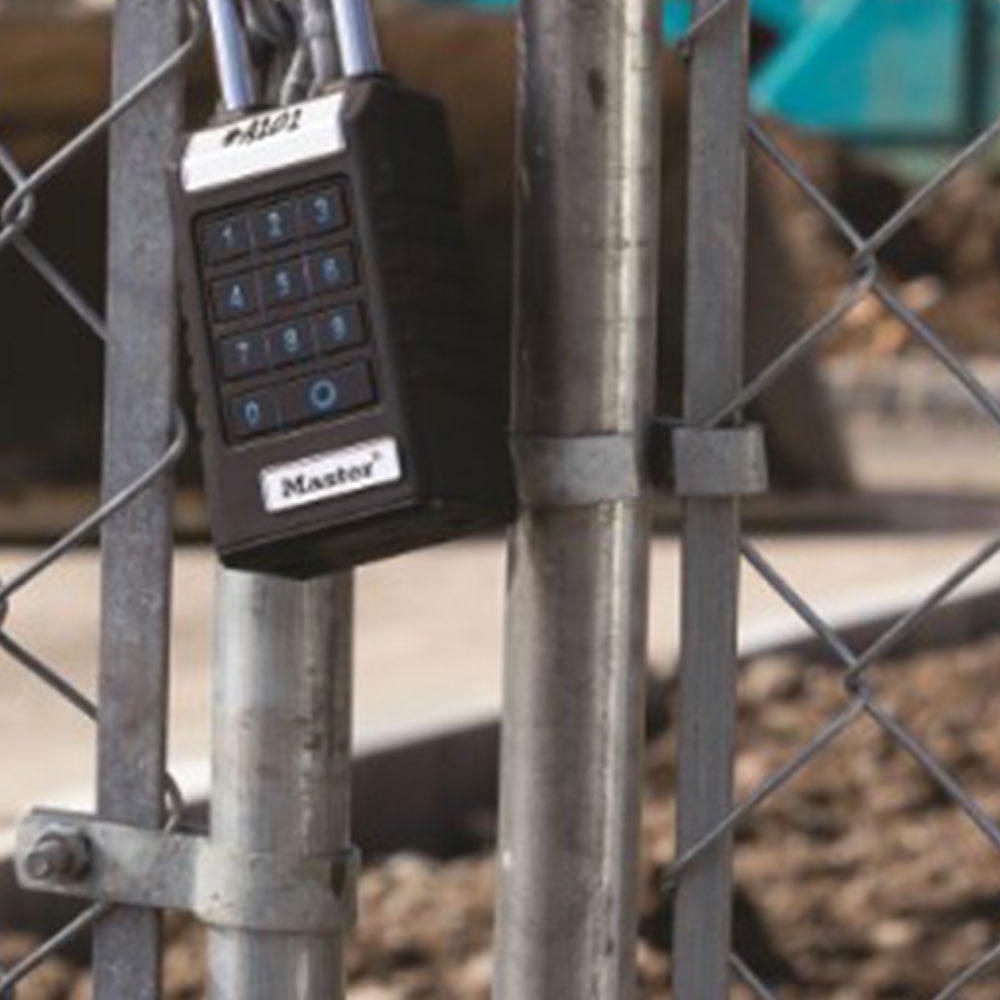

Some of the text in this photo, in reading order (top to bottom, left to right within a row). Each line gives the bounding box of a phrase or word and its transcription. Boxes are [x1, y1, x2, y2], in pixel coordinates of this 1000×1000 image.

[221, 197, 330, 247] 1 2 3
[229, 257, 338, 309] 4 5 6
[235, 341, 250, 364] 7
[330, 315, 346, 341] 9
[245, 400, 260, 426] 0
